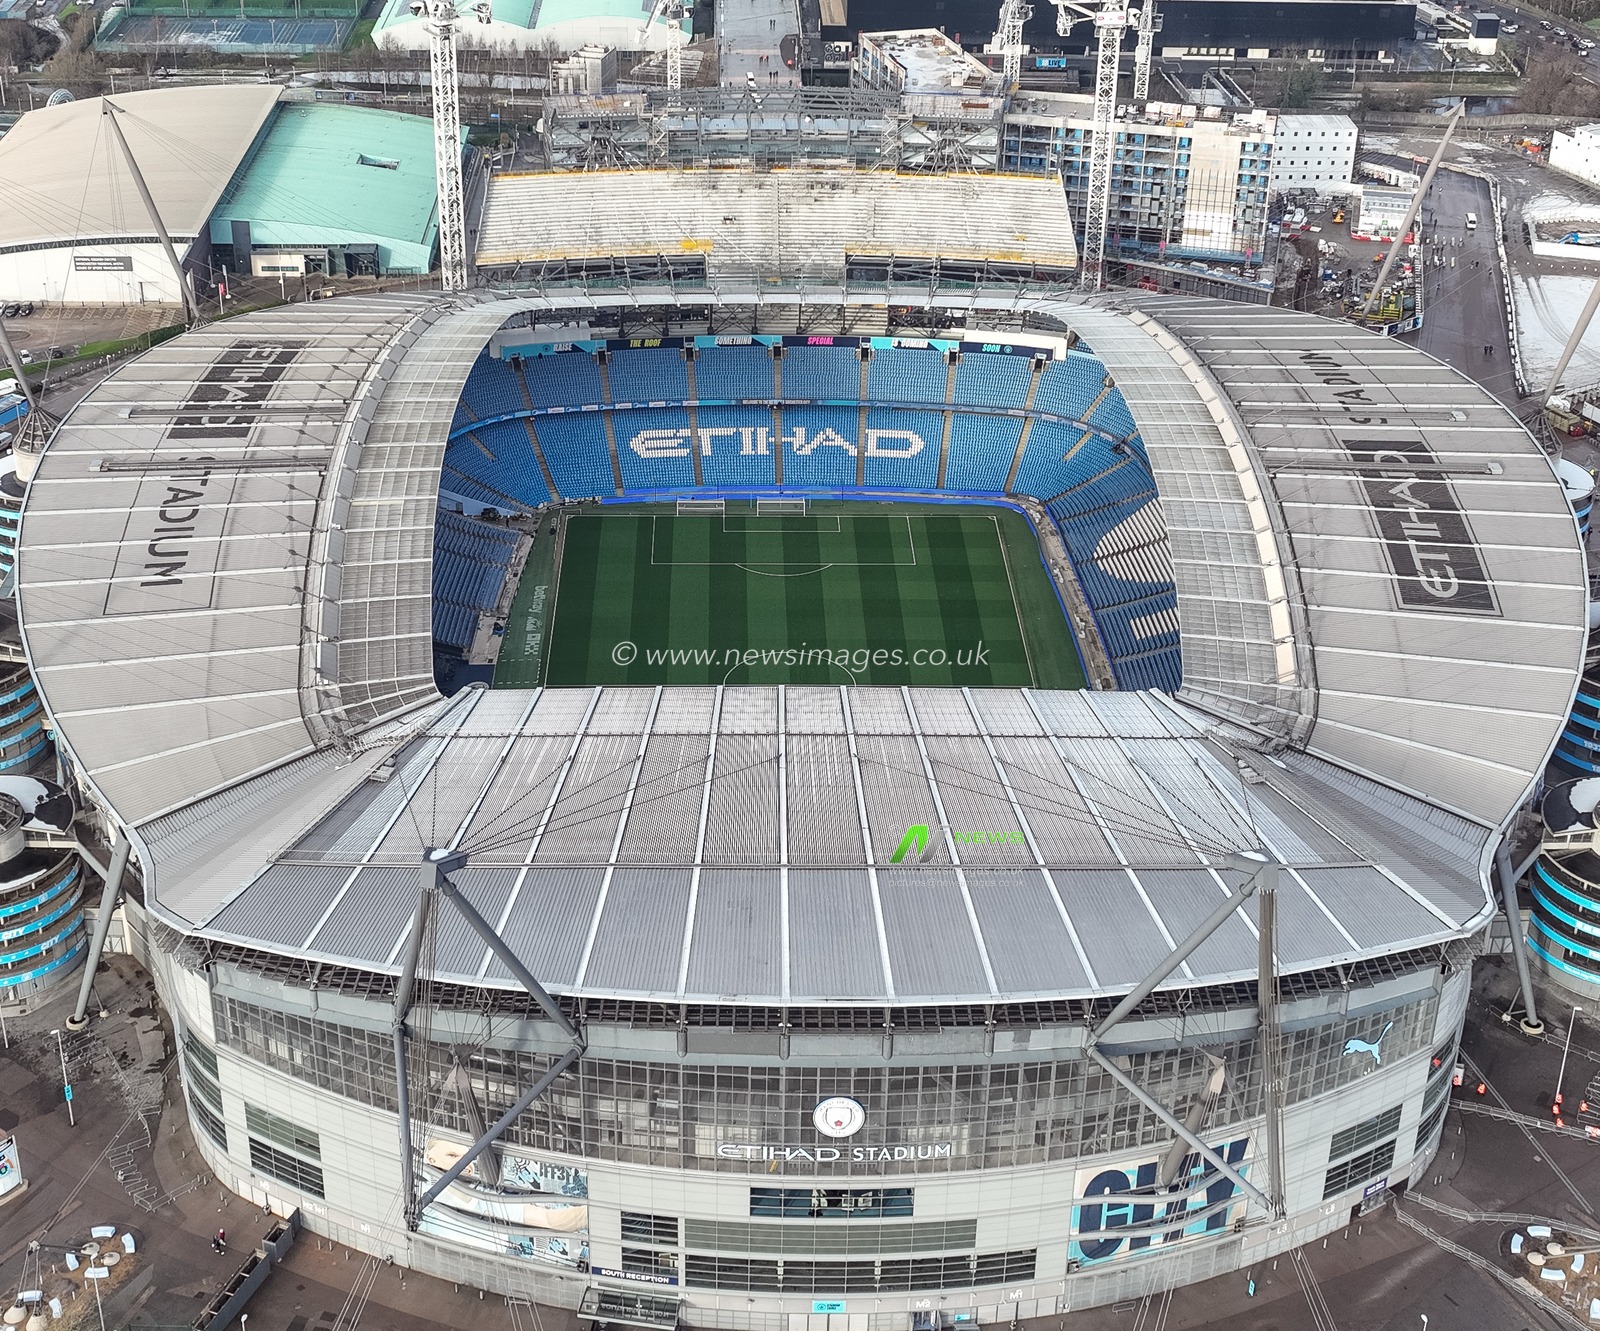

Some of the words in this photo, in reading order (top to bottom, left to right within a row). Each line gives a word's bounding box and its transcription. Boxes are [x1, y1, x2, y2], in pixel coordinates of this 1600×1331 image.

[630, 339, 642, 348] THE
[644, 338, 662, 347] ROOF
[714, 336, 752, 345] SOMETHING
[807, 336, 834, 345] SPECIAL
[553, 342, 573, 352] RAISE
[982, 343, 1000, 353] SOON
[630, 426, 925, 459] ETIHAD
[1374, 450, 1458, 598] ETIHAD
[2, 926, 25, 940] CITY
[41, 934, 59, 951] CITY
[717, 1144, 841, 1161] ETIHAD
[853, 1143, 952, 1161] STADIUM
[601, 1269, 625, 1279] SOUTH
[626, 1272, 670, 1284] RECEPTION
[915, 1299, 931, 1309] M2
